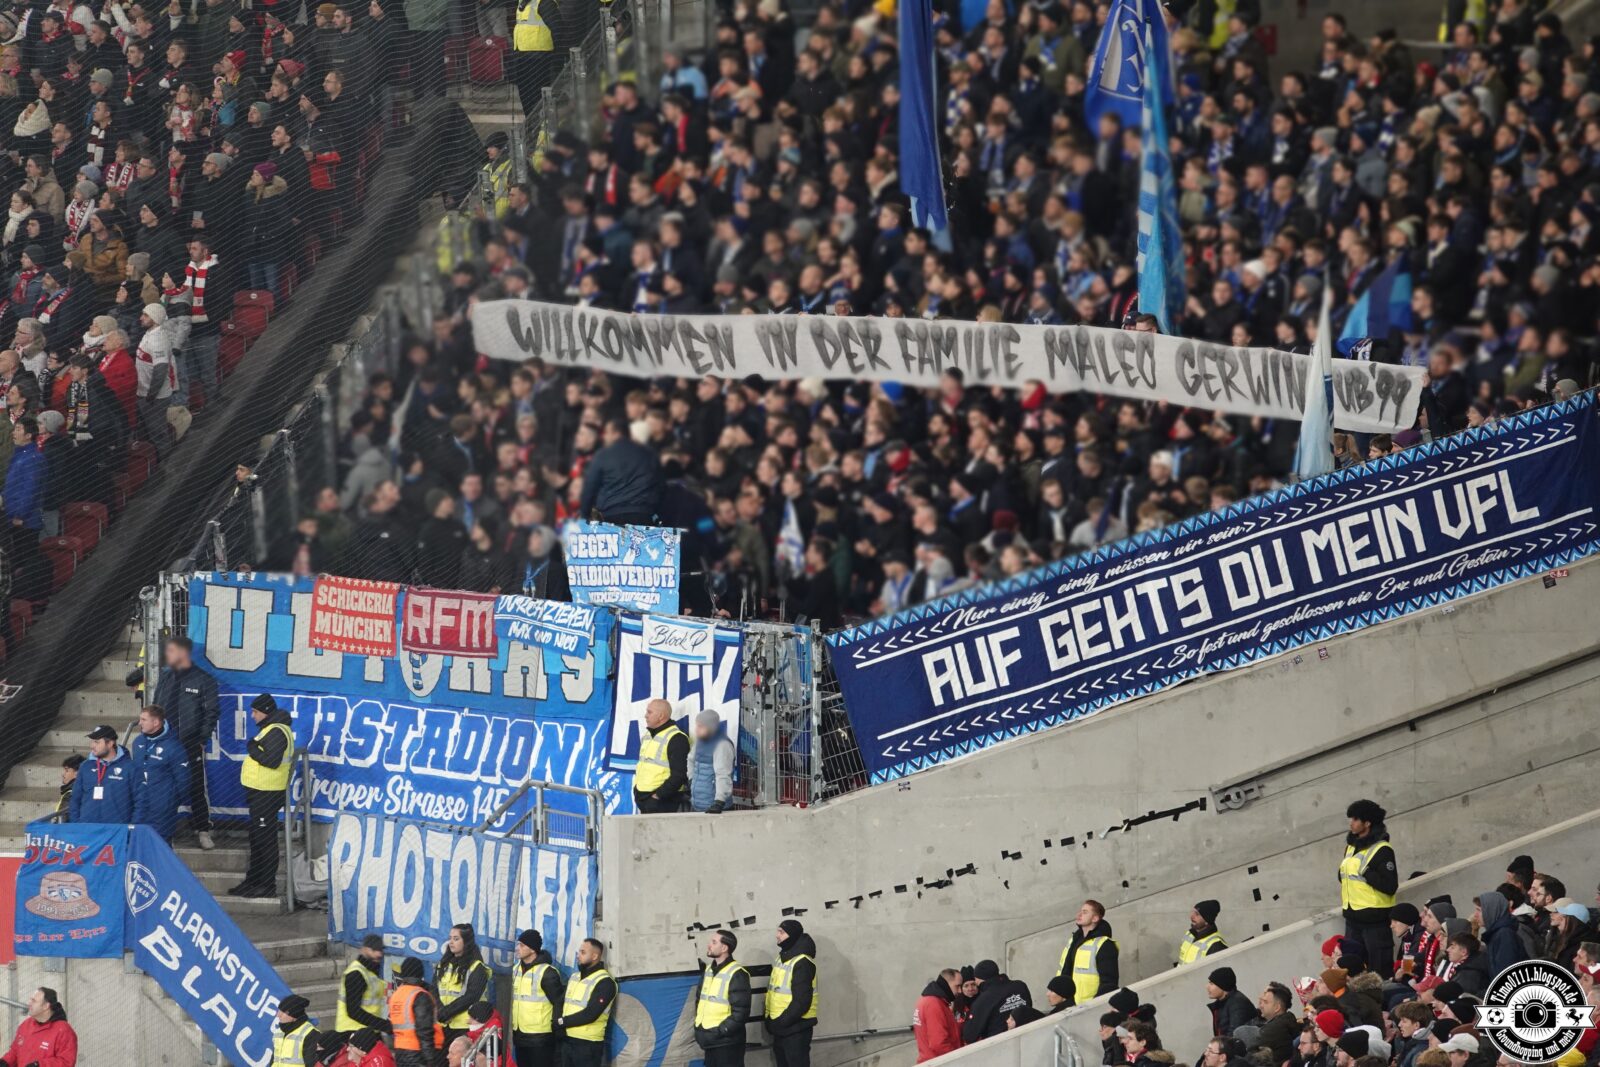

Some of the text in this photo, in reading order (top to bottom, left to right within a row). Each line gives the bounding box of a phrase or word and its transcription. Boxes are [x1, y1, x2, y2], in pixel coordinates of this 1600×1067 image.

[506, 306, 736, 373] WILLKOMMEN
[756, 316, 797, 372] IN
[810, 318, 892, 374] DER
[896, 321, 1020, 379] FAMILIE
[1176, 342, 1307, 414] GERWIN
[569, 533, 619, 559] GEGEN
[567, 565, 676, 589] STADIONVERBOTE
[922, 470, 1539, 706] AUF GEHTS DU MEIN VFL
[942, 606, 996, 630] Nur
[1001, 592, 1050, 613] einig,
[1057, 572, 1099, 594] einig
[1105, 551, 1169, 578] müssen
[1174, 537, 1204, 555] wir
[316, 584, 393, 615] SCHICKERIA
[496, 595, 595, 630] DURCHZIEHEN
[1167, 548, 1511, 669] So fest und geschlossen wie Erz und Gestein
[315, 609, 393, 643] MÜNCHEN
[407, 594, 493, 648] RFM
[508, 621, 533, 639] MAX
[554, 632, 578, 652] NICO
[649, 624, 688, 650] Block
[384, 775, 468, 822] Strasse
[93, 844, 116, 866] A
[139, 925, 273, 1067] BLAU
